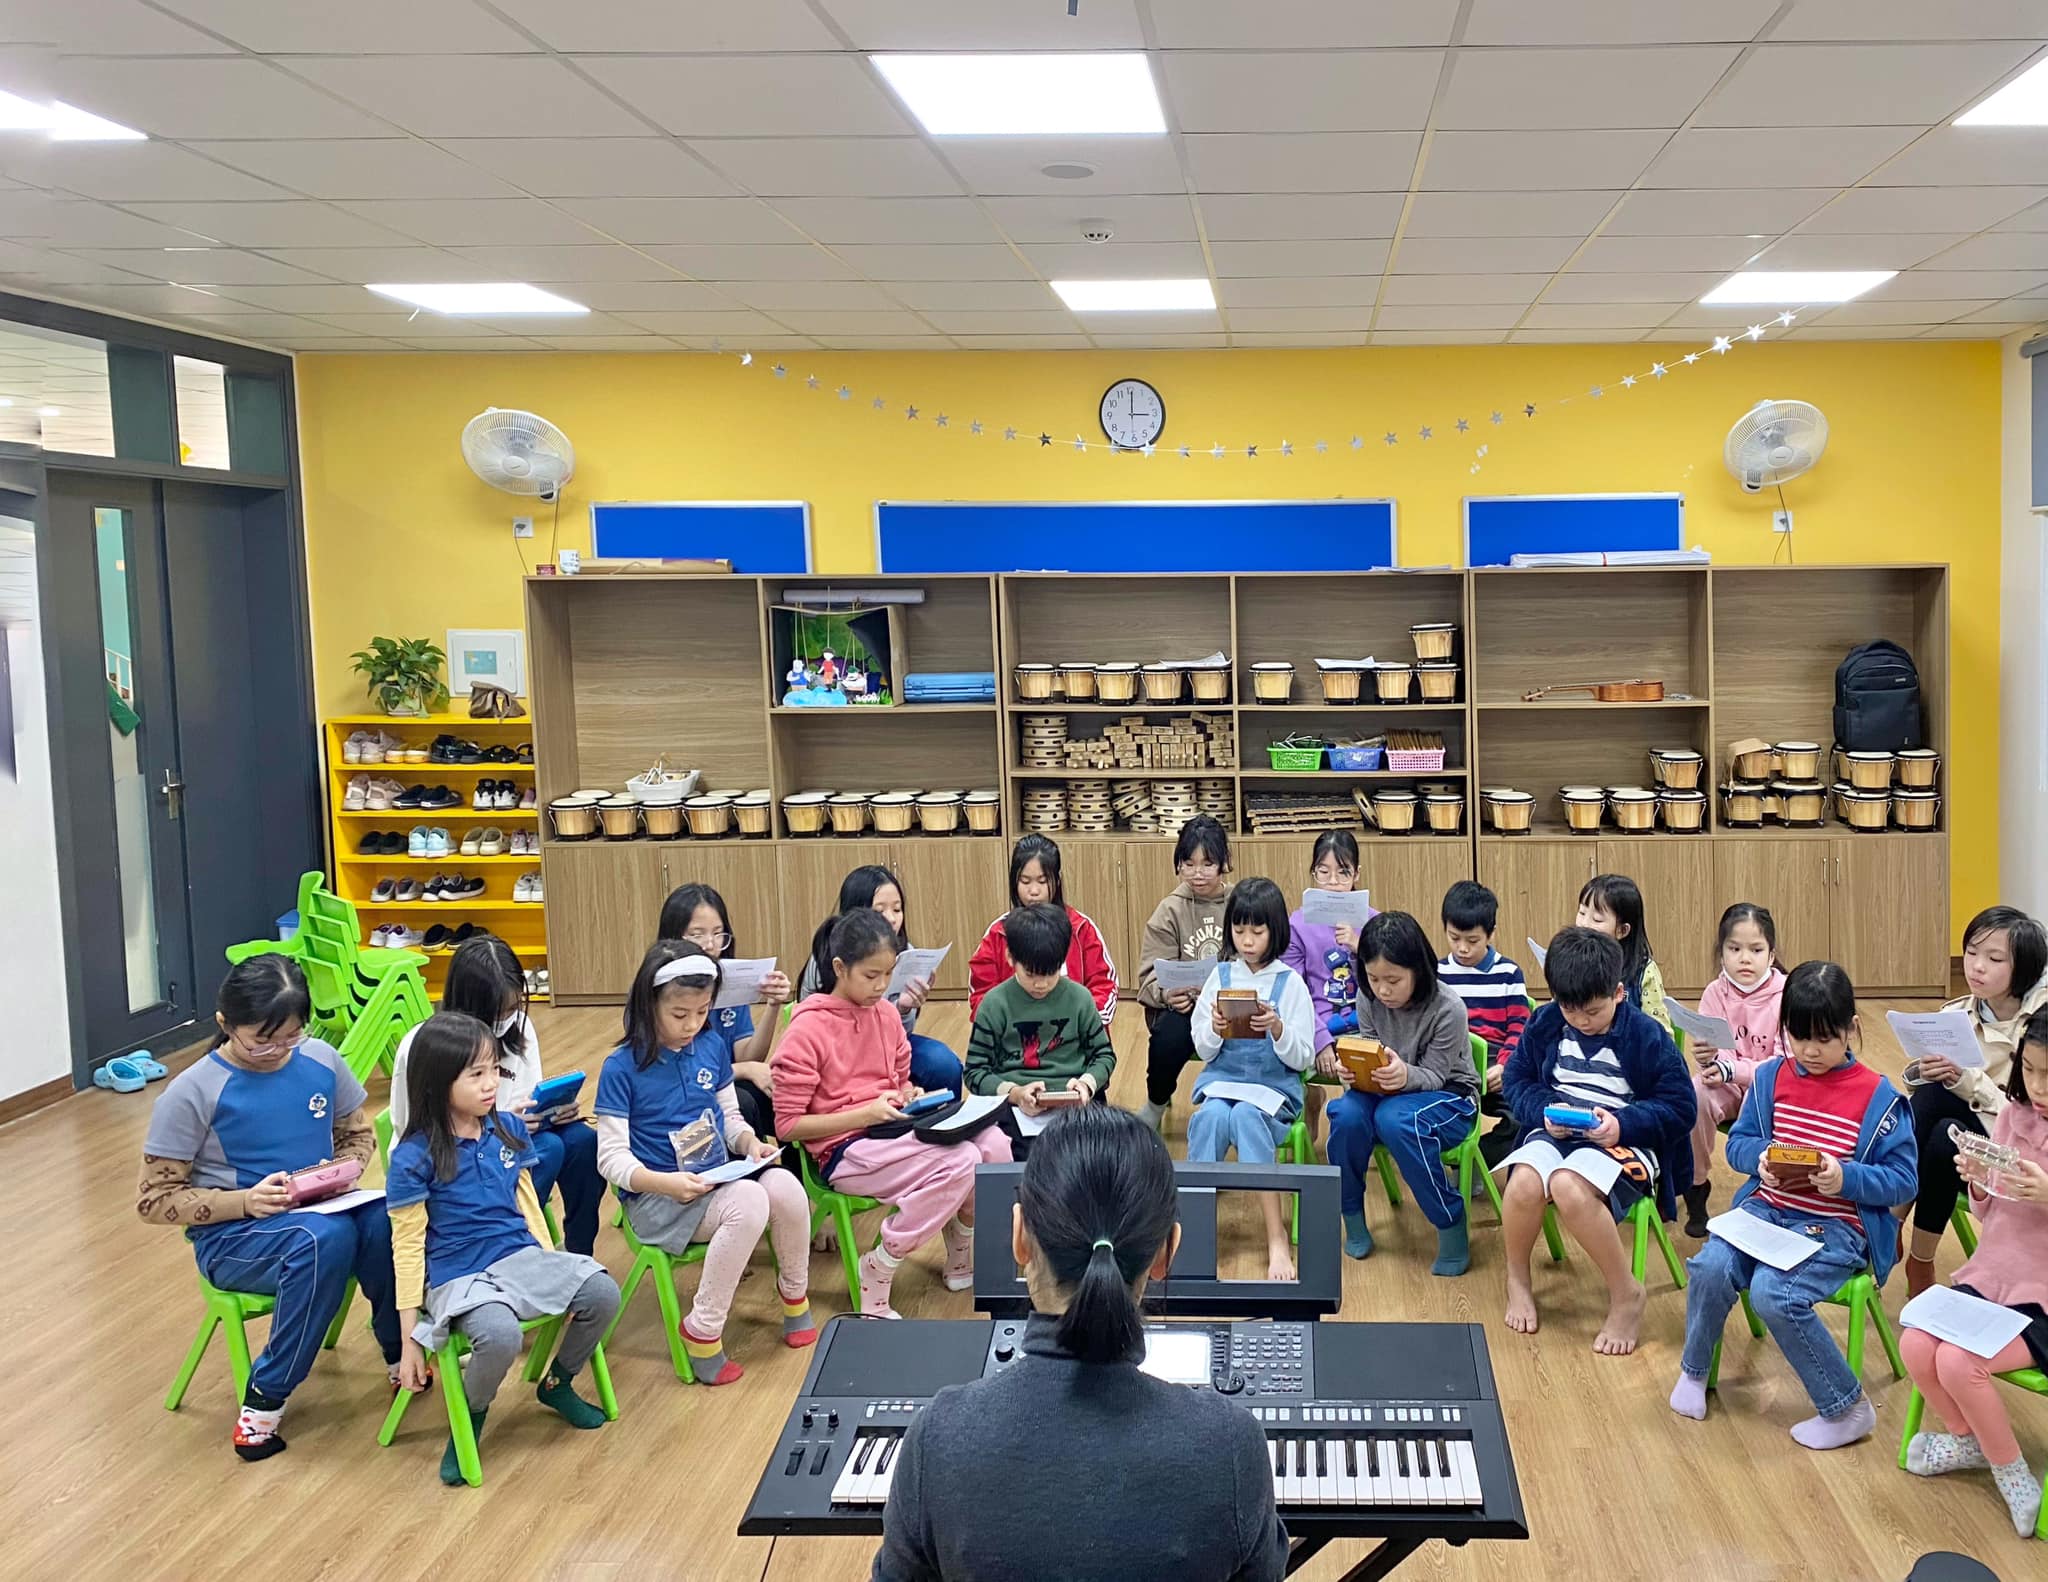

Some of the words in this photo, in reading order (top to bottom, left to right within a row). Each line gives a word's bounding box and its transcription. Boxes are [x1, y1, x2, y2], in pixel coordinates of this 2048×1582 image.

[1116, 390, 1124, 399] 11
[1109, 400, 1118, 409] 10
[1107, 411, 1113, 421] 9
[1152, 408, 1158, 418] 3
[1111, 423, 1118, 432] 8
[1149, 421, 1155, 430] 4
[1120, 430, 1126, 440] 7
[1131, 433, 1138, 443] 6
[1142, 429, 1148, 438] 5
